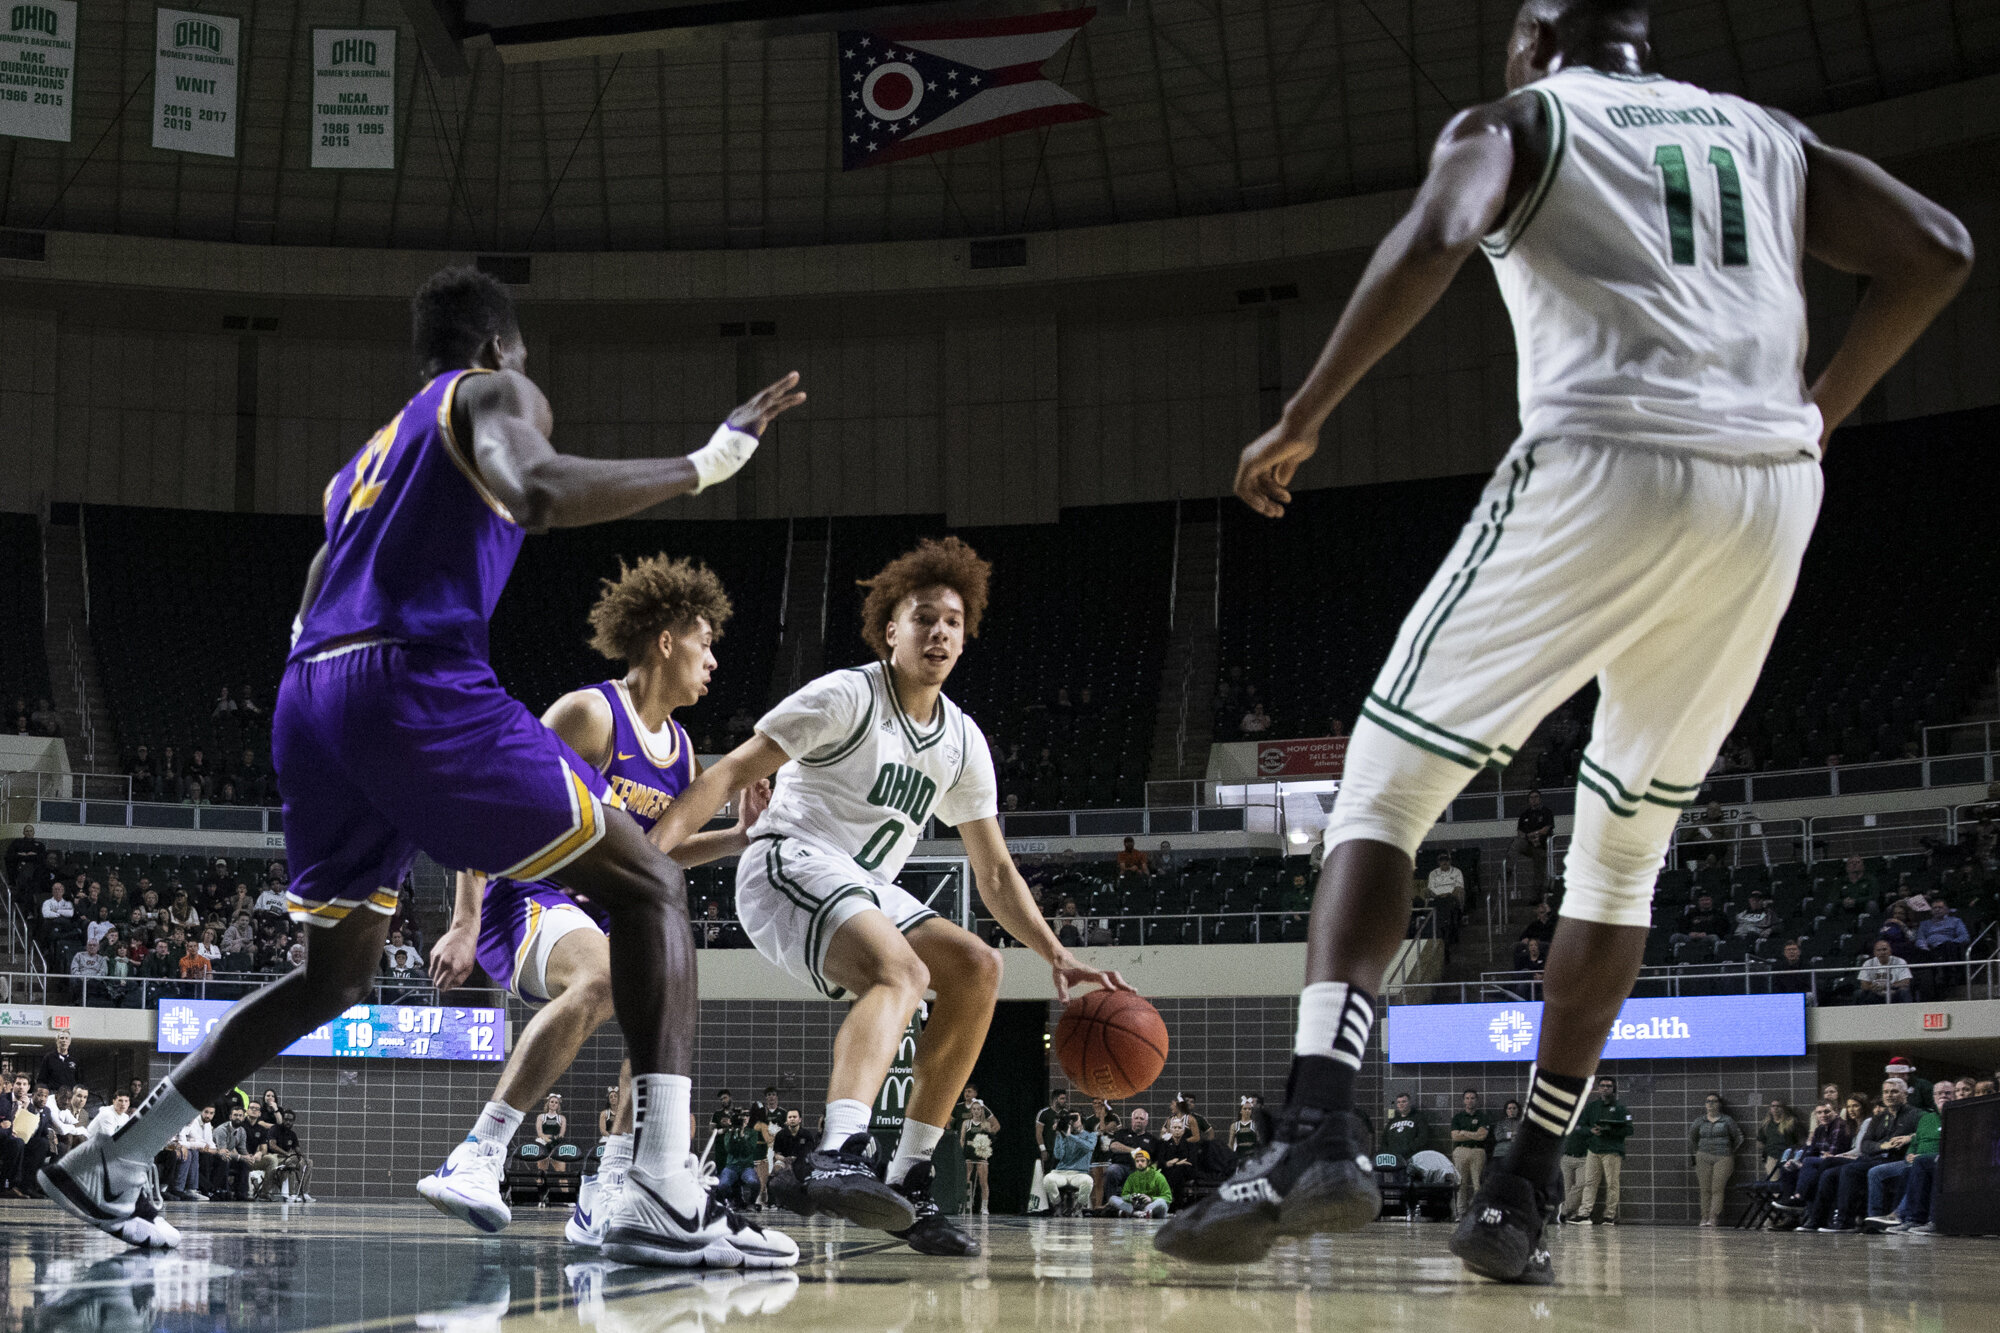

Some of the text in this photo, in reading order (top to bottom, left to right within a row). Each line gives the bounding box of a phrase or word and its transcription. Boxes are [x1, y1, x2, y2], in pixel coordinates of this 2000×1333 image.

[12, 5, 57, 36] OHIO
[175, 21, 220, 52] OHIO
[20, 51, 46, 64] MAC
[332, 39, 376, 66] OHIO
[0, 72, 64, 90] CHAMPIONS
[175, 75, 216, 95] WNIT
[0, 89, 63, 106] 1986 2015
[338, 92, 368, 104] NCAA
[163, 104, 227, 123] 2016 2017
[317, 104, 389, 116] TOURNAMENT
[163, 117, 192, 131] 2019
[322, 123, 384, 135] 1986 1995
[321, 135, 350, 147] 2015
[1654, 144, 1749, 267] 11
[1286, 745, 1308, 753] NOW
[1310, 743, 1333, 752] OPEN
[1314, 759, 1340, 768] Athens,
[867, 763, 936, 825] OHIO
[1681, 809, 1739, 823] SERED
[853, 819, 905, 871] 0
[55, 1015, 70, 1028] EXIT
[398, 1007, 442, 1033] 9:17
[472, 1009, 495, 1023] TTU
[1923, 1013, 1943, 1028] EXIT
[345, 1022, 373, 1048] 19
[378, 1037, 405, 1046] BONUS
[467, 1025, 494, 1051] 12
[876, 1115, 891, 1125] i'm
[1389, 1120, 1414, 1131] OHIO
[522, 1145, 539, 1155] OHIO
[559, 1145, 576, 1155] OHIO
[1377, 1154, 1395, 1166] OHIO
